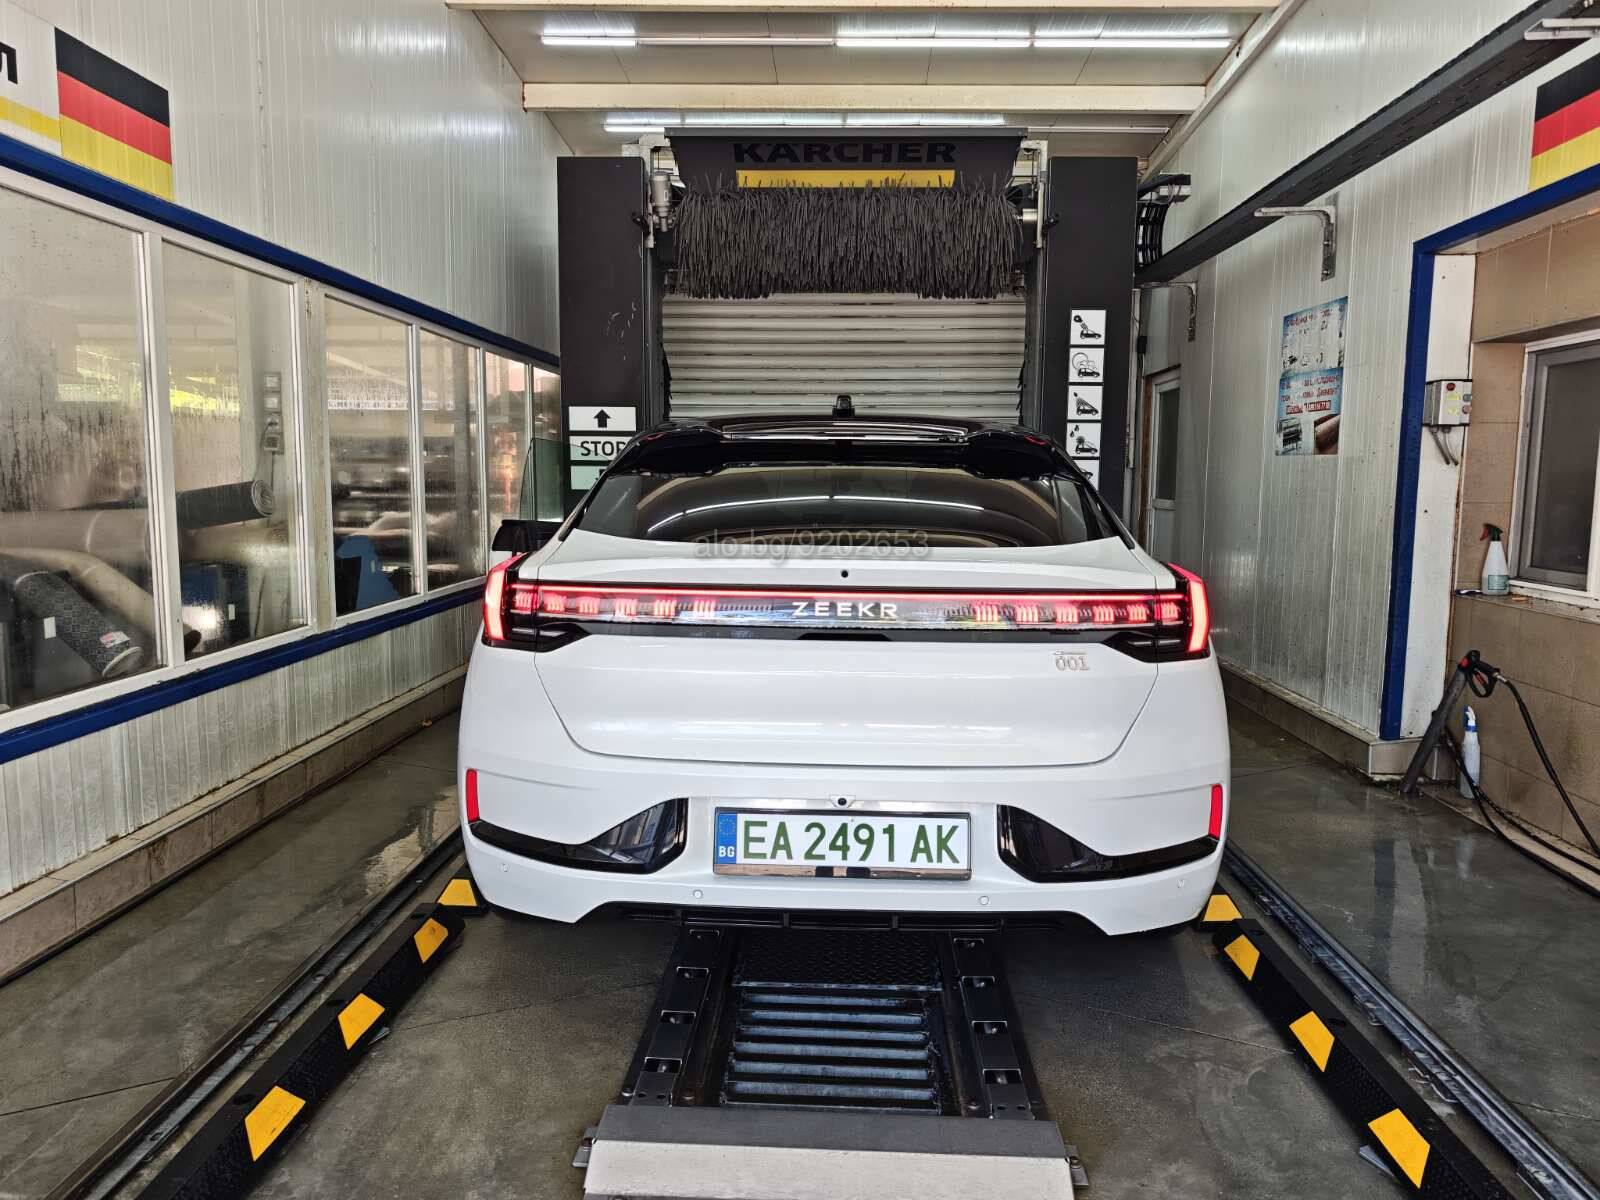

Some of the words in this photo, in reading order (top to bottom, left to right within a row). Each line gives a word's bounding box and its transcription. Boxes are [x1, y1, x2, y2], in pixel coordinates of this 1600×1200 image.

[733, 142, 957, 164] KÄRCHER
[791, 600, 899, 619] ZEEKR
[1055, 655, 1089, 671] 001
[718, 845, 735, 858] BG
[743, 820, 793, 860] EA
[804, 822, 895, 863] 2491
[910, 824, 961, 864] AK
